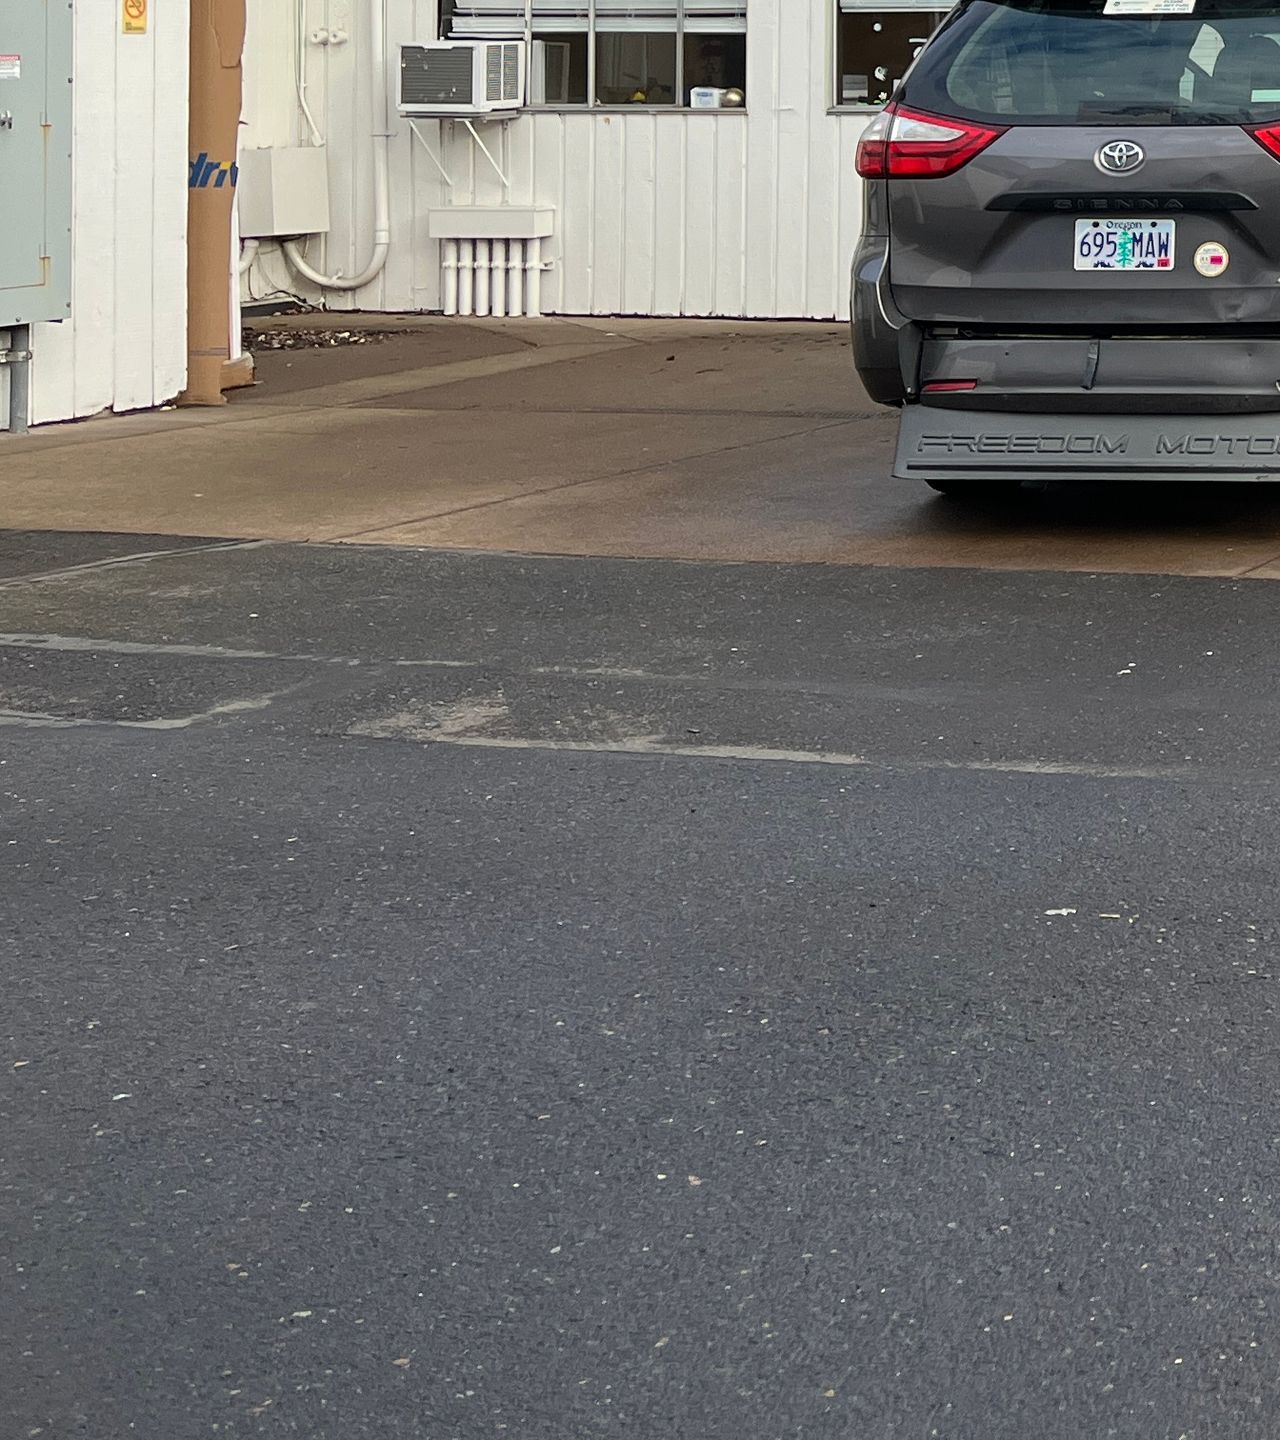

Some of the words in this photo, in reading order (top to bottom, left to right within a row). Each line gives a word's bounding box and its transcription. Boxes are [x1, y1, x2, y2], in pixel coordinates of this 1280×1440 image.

[1053, 198, 1184, 209] SIENNA
[1106, 220, 1143, 231] Oregon
[1080, 231, 1118, 258] 695
[1131, 231, 1170, 258] MAW
[917, 432, 1129, 455] FREEDOM
